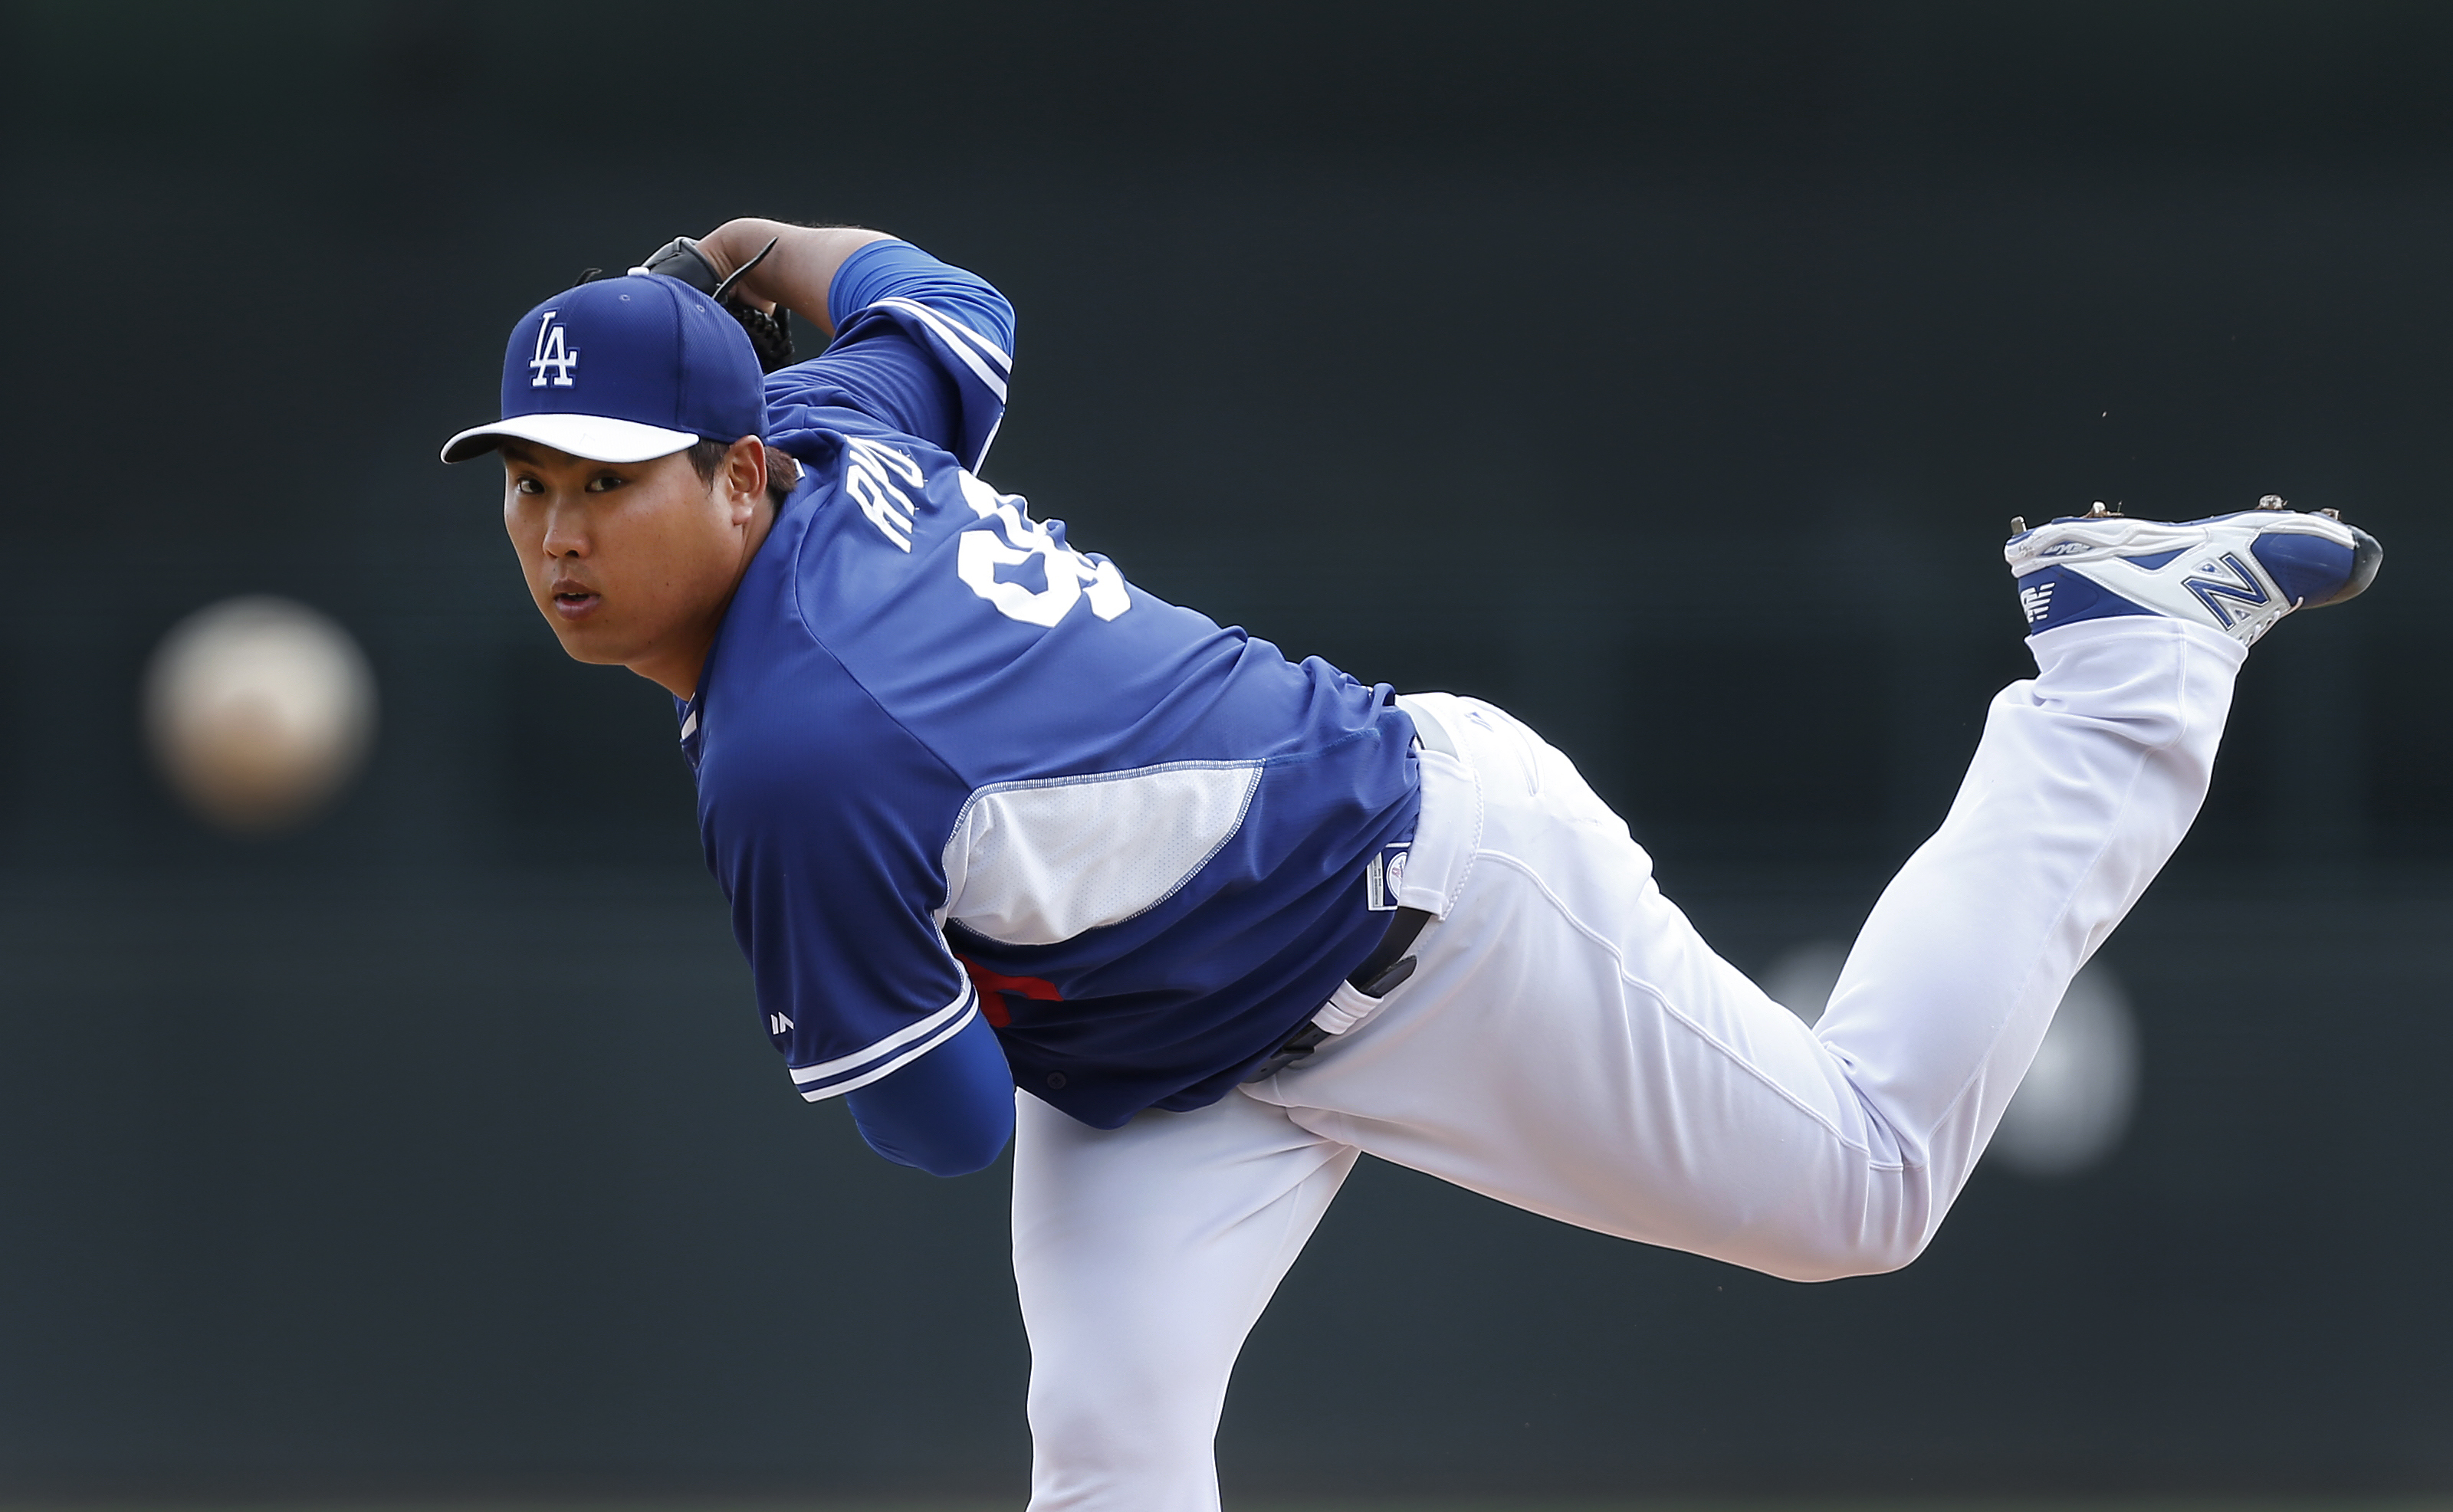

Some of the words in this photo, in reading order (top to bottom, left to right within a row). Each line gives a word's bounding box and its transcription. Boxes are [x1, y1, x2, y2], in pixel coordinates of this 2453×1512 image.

[530, 310, 578, 387] LA
[844, 435, 925, 554] RYU
[2180, 552, 2271, 631] N
